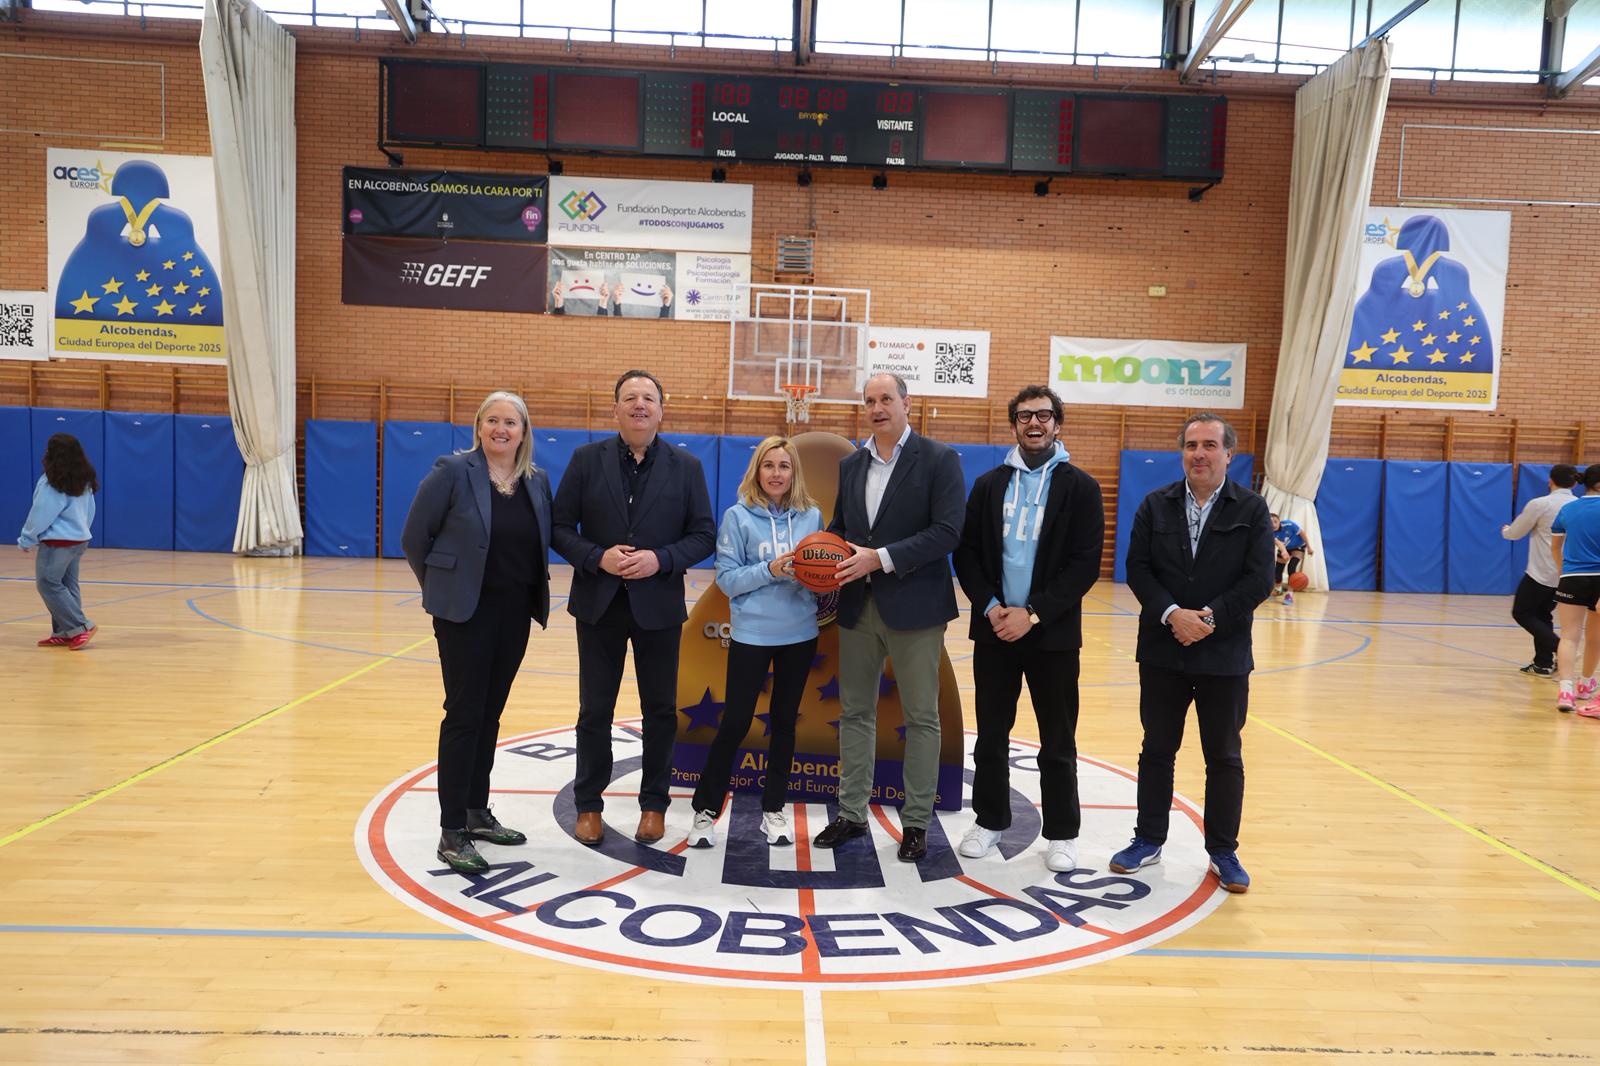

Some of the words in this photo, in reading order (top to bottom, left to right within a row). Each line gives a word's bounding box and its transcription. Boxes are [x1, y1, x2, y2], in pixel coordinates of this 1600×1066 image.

[712, 111, 749, 123] LOCAL
[877, 120, 913, 131] VISITANTE
[717, 150, 736, 158] FALTAS
[53, 165, 100, 182] aces
[70, 181, 99, 189] EUROPE
[349, 180, 362, 190] EN
[364, 180, 429, 192] ALCOBENDAS
[431, 183, 468, 194] DAMOS
[470, 185, 482, 194] LA
[483, 186, 510, 196] CARA
[512, 187, 532, 197] POR
[534, 188, 543, 198] TI
[526, 210, 538, 220] fin
[617, 204, 660, 214] Fundación
[662, 206, 696, 217] Deporte
[698, 207, 746, 218] Alcobendas
[558, 222, 605, 233] FUNDAL
[639, 220, 724, 230] #TODOSCONJUGAMOS
[1364, 223, 1386, 237] es
[584, 251, 594, 259] En
[595, 252, 624, 260] CENTRO
[626, 252, 640, 260] TAP
[424, 263, 492, 288] GEFF
[100, 324, 177, 338] Alcobendas,
[58, 336, 92, 348] Ciudad
[96, 338, 135, 350] Europea
[138, 340, 152, 350] del
[156, 341, 196, 352] Deporte
[198, 342, 222, 352] 2025
[872, 364, 912, 372] PATROCINA
[1058, 354, 1232, 386] moonz
[1376, 373, 1447, 385] Alcobendas,
[1178, 386, 1232, 398] ortodoncia
[1337, 385, 1368, 395] Ciudad
[1370, 386, 1408, 398] Europea
[1410, 388, 1424, 396] del
[1426, 388, 1464, 400] Deporte
[1466, 390, 1488, 398] 2025
[802, 549, 844, 562] Wilson
[671, 768, 700, 782] Prem
[427, 861, 1152, 958] ALCOBENDAS
